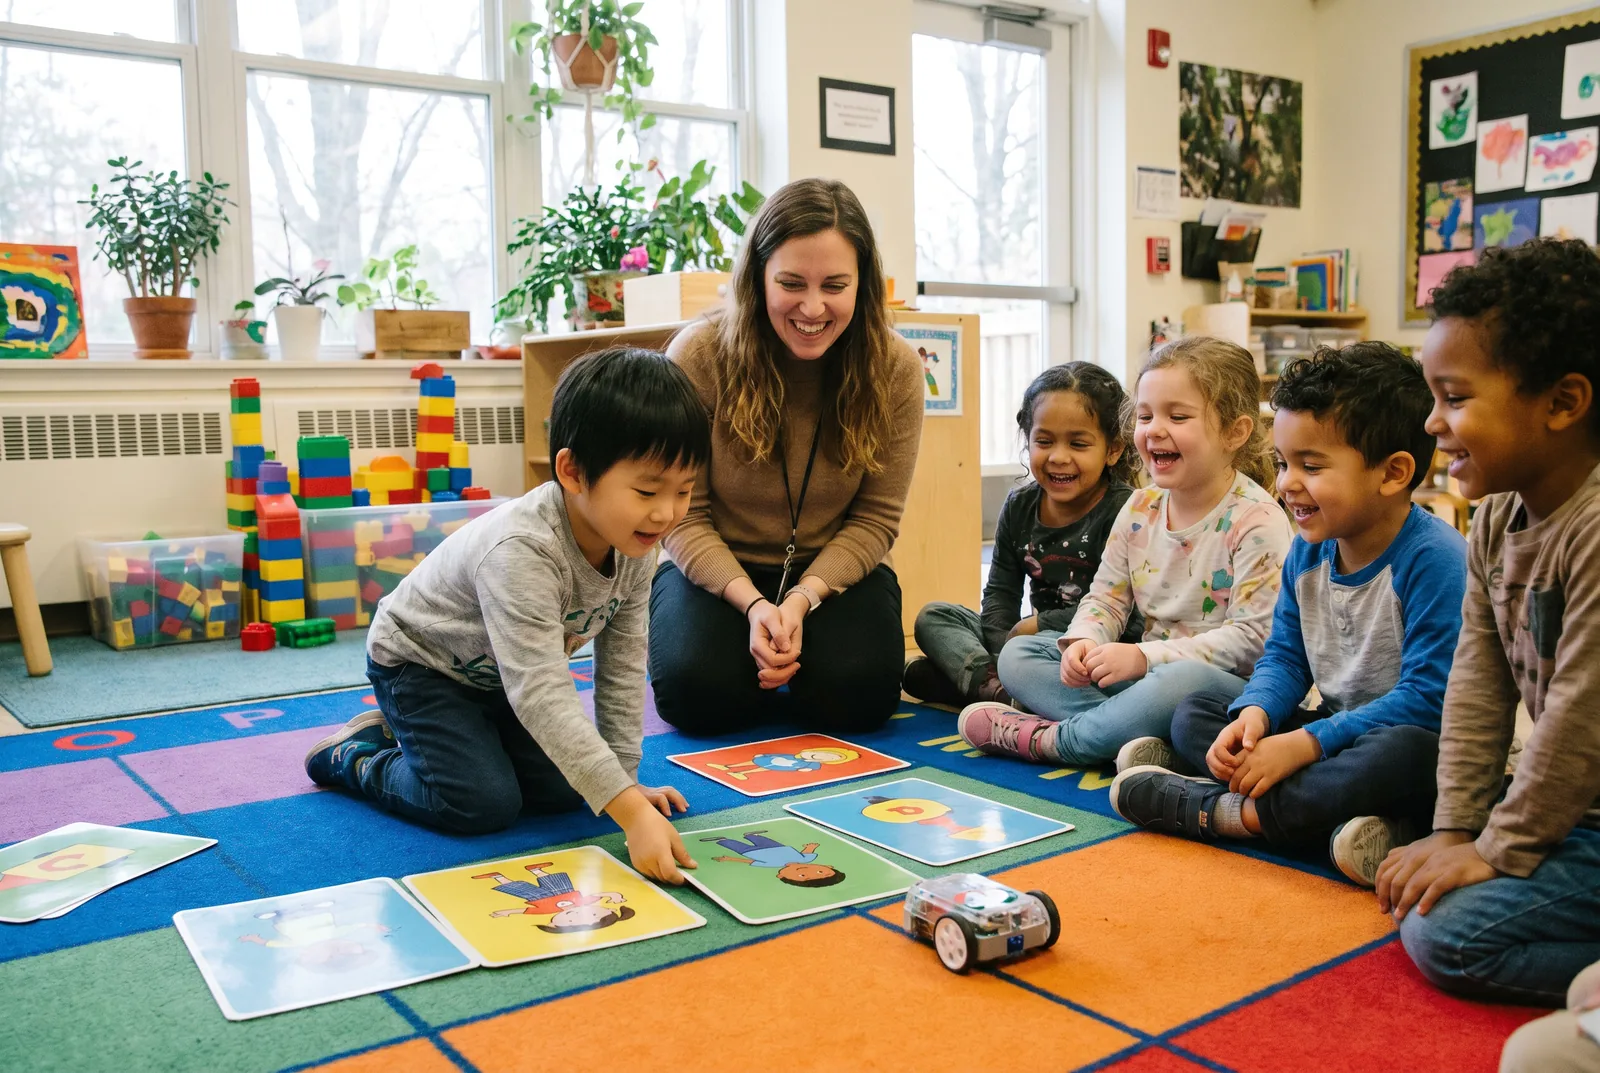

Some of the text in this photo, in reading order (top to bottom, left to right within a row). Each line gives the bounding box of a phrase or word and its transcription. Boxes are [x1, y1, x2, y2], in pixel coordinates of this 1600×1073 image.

[53, 708, 285, 750] O P
[37, 853, 89, 871] C
